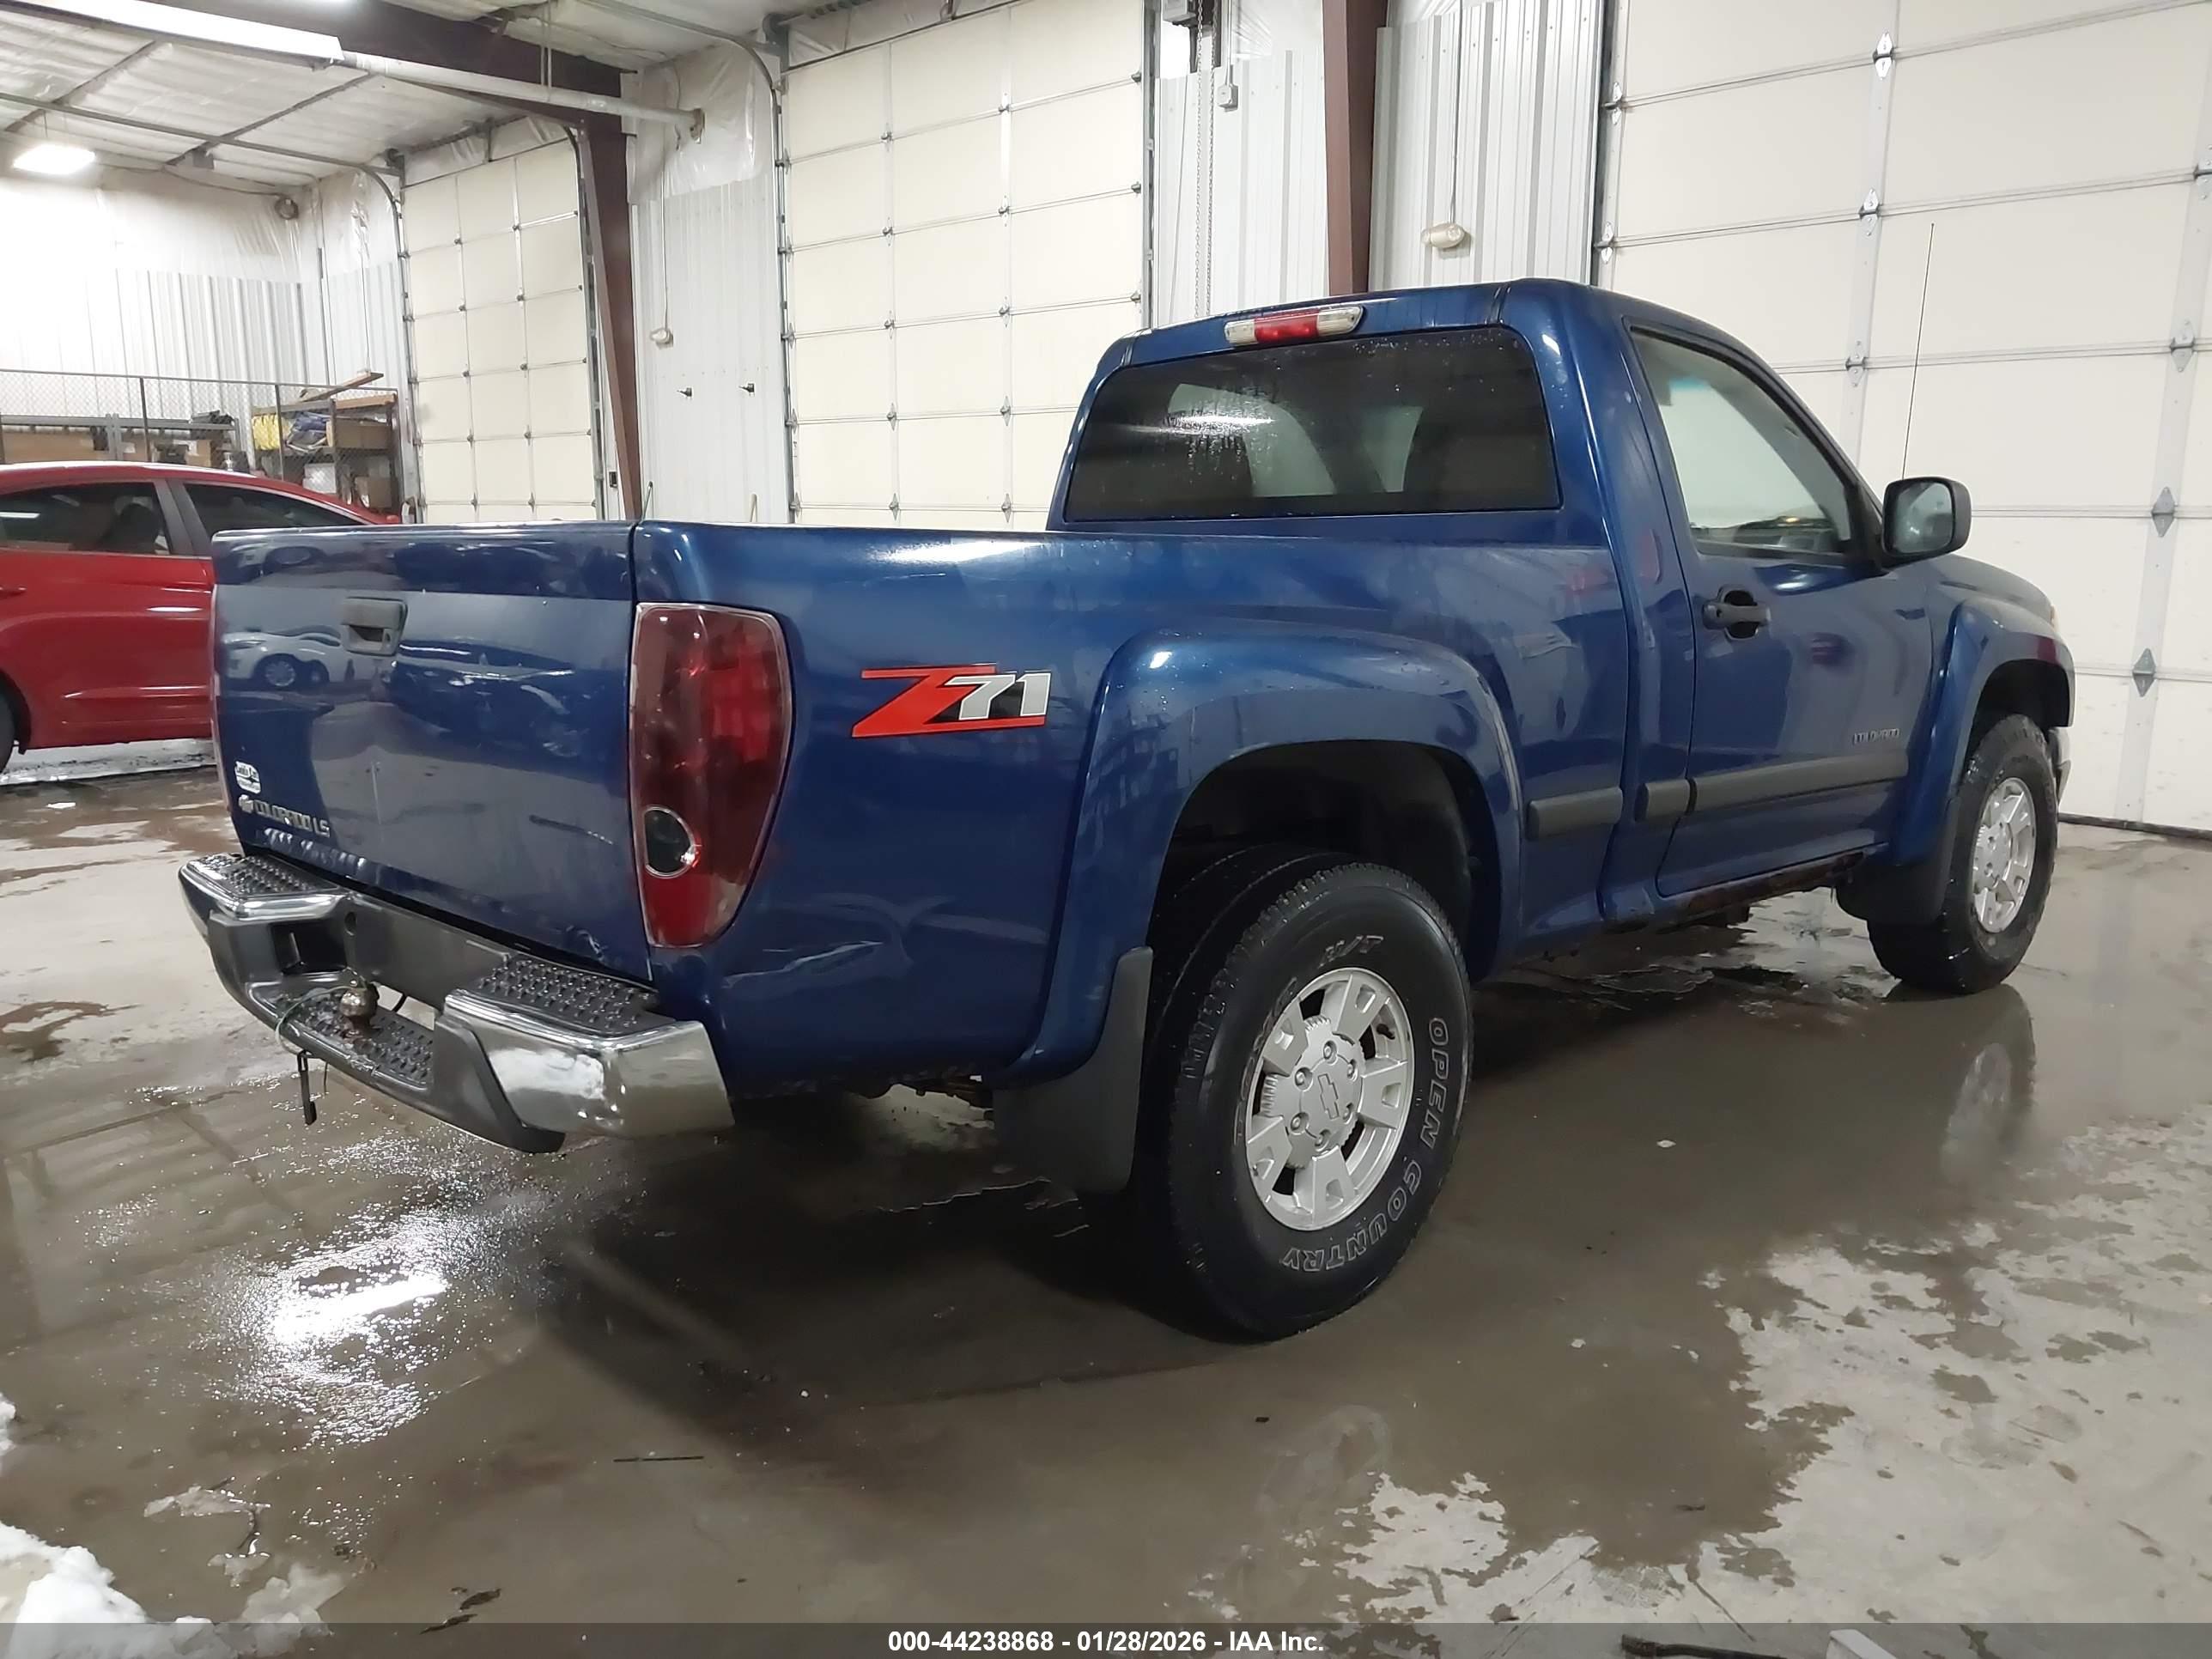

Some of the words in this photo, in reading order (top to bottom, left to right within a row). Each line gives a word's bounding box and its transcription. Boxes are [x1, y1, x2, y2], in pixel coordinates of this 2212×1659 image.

[852, 665, 1052, 738] Z71
[313, 817, 331, 837] LS
[1420, 1017, 1449, 1149] OPEN
[1281, 1160, 1422, 1271] COUNTRY
